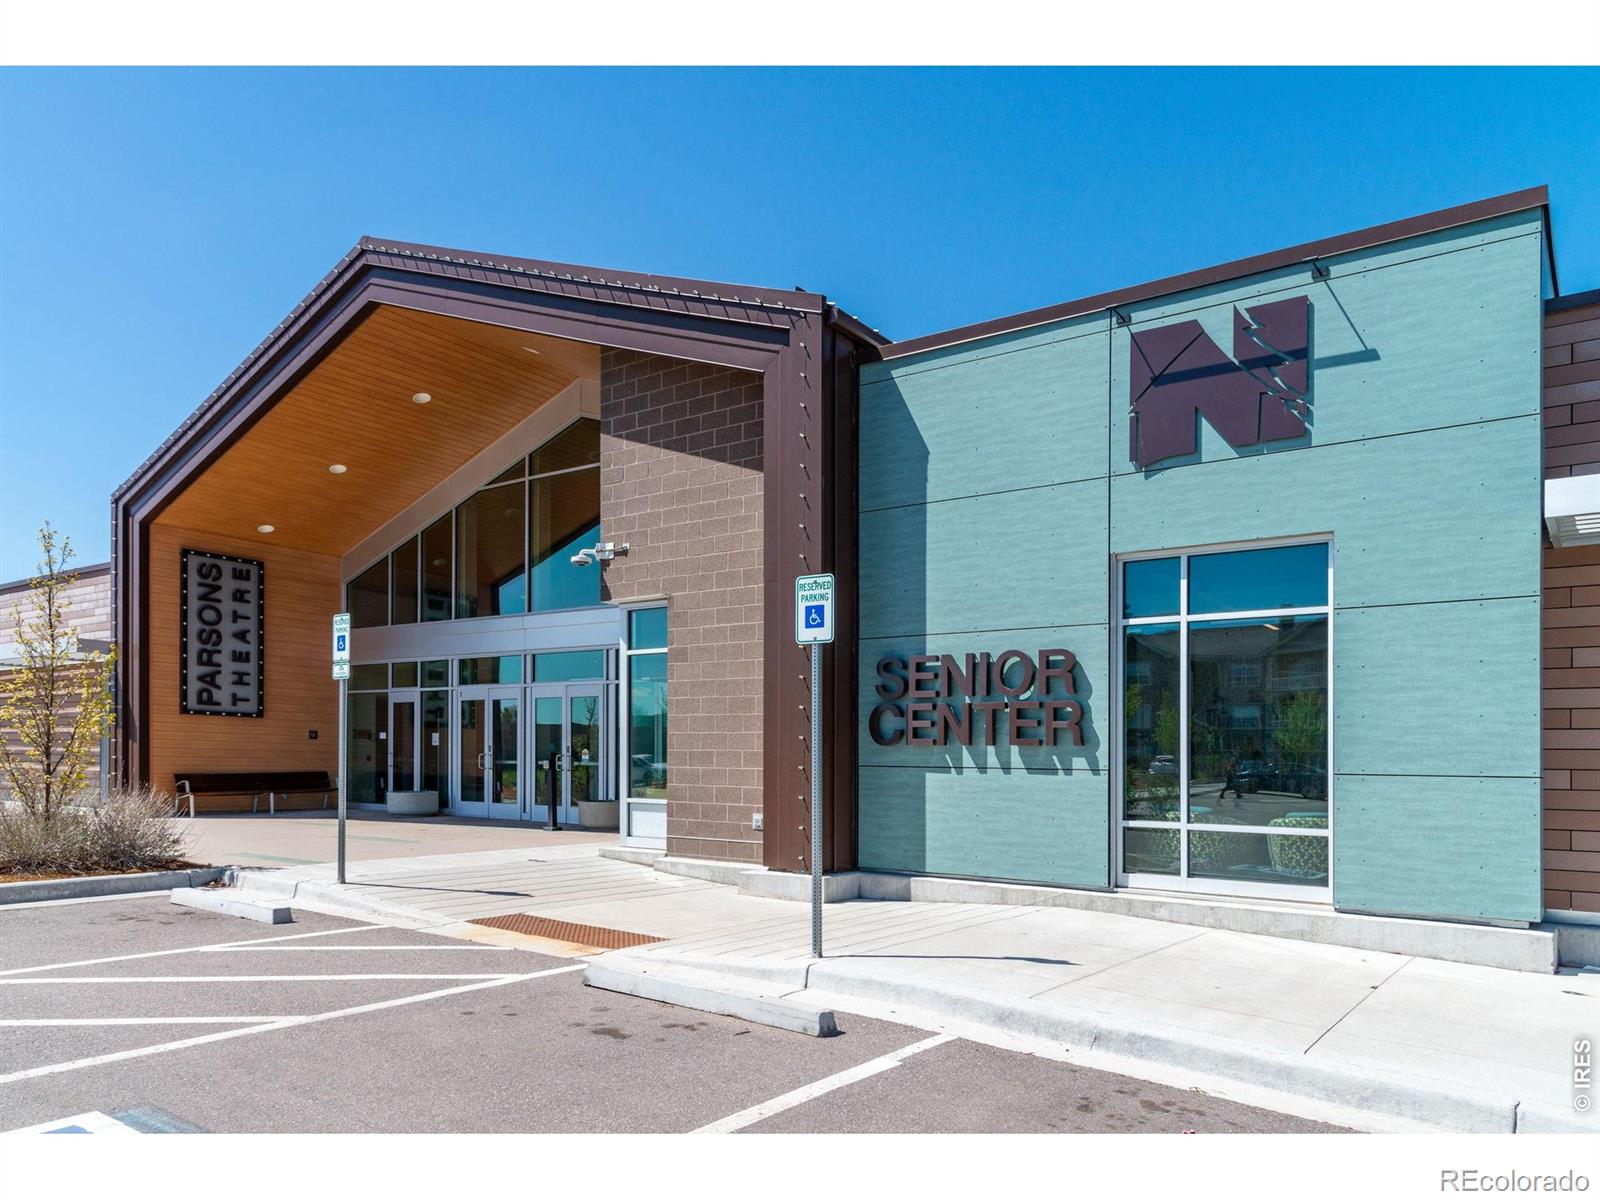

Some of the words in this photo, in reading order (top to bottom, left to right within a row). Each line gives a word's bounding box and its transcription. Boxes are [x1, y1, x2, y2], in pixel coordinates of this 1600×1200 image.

[799, 581, 832, 592] RESERVED
[800, 592, 829, 602] PARKING
[196, 562, 222, 706] PARSONS
[231, 567, 251, 706] THEATRE
[875, 648, 1078, 700] SENIOR
[868, 700, 1085, 746] CENTER
